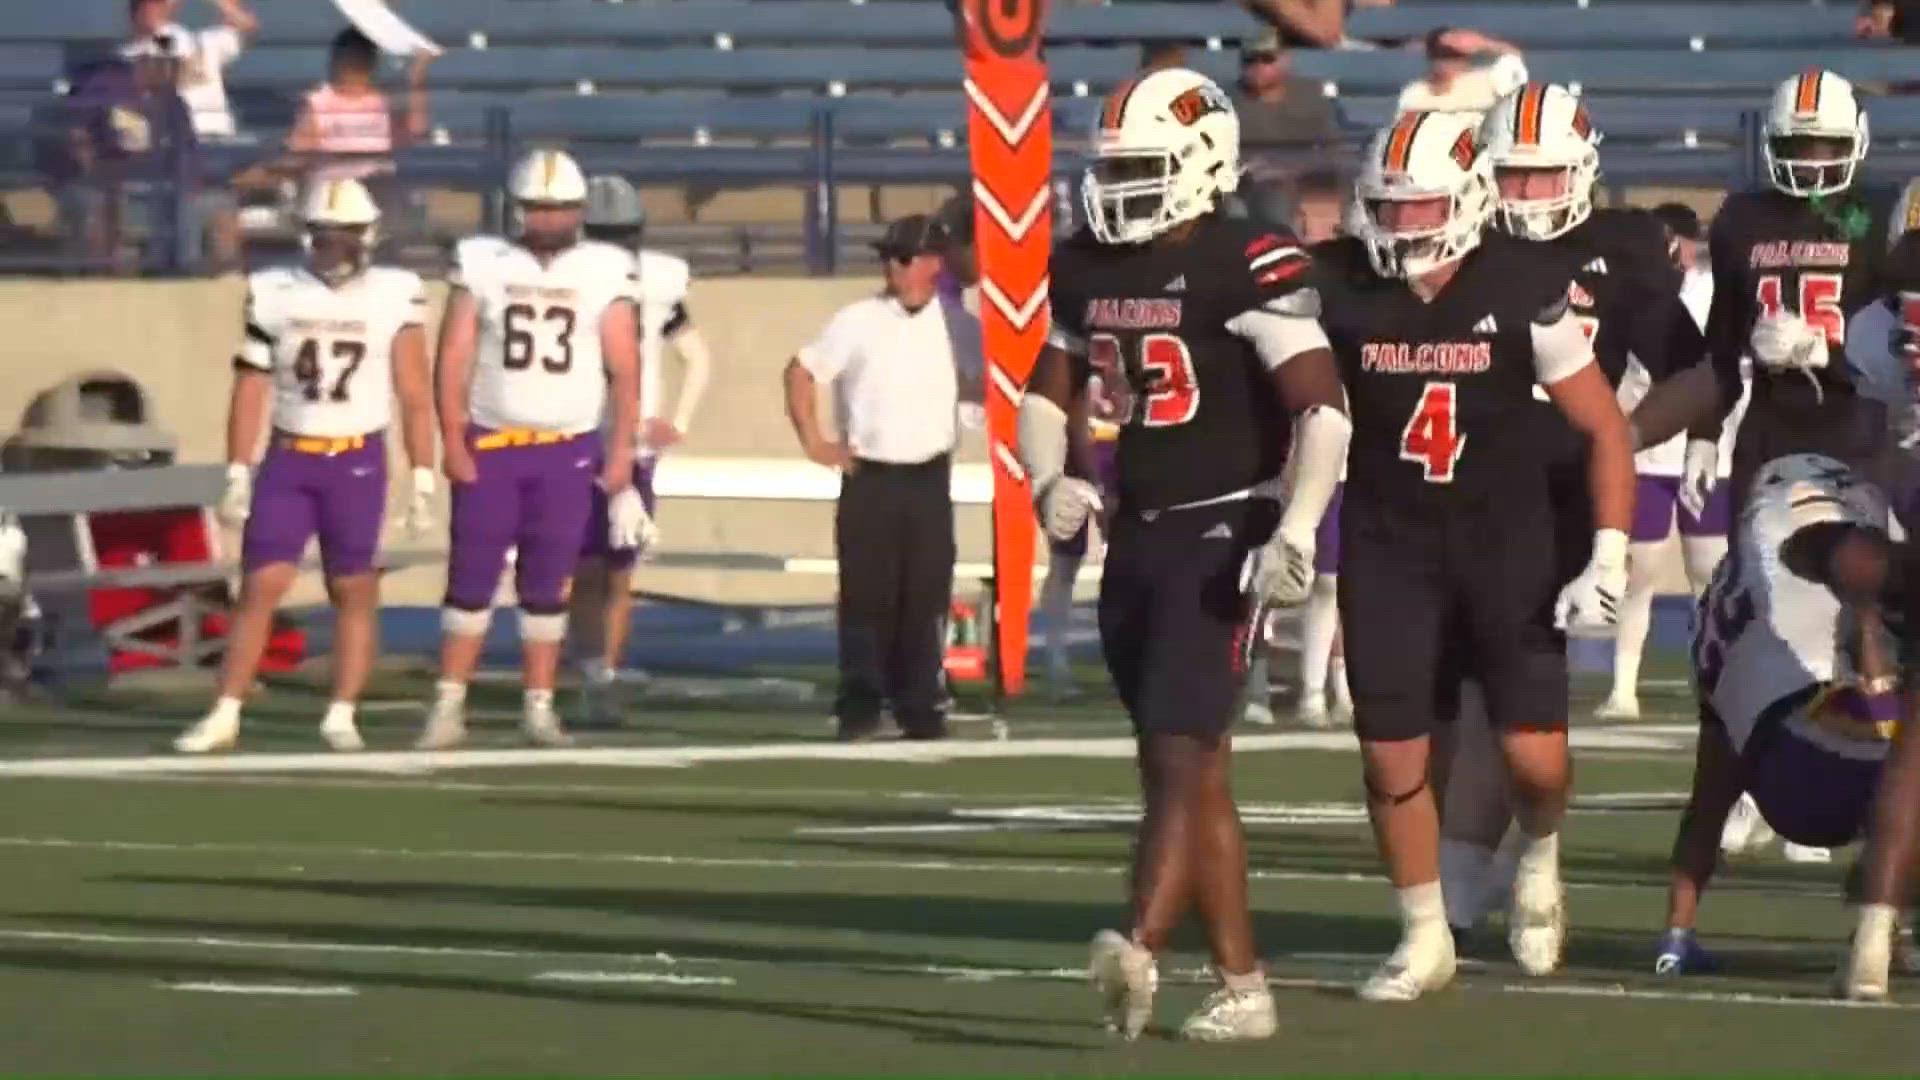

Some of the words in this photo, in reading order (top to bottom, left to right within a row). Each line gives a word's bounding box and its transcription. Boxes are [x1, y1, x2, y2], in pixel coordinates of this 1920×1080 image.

[502, 303, 577, 373] 63
[1756, 272, 1845, 346] 15
[293, 337, 367, 401] 47
[1361, 342, 1491, 374] FALCONS
[1399, 381, 1467, 483] 4
